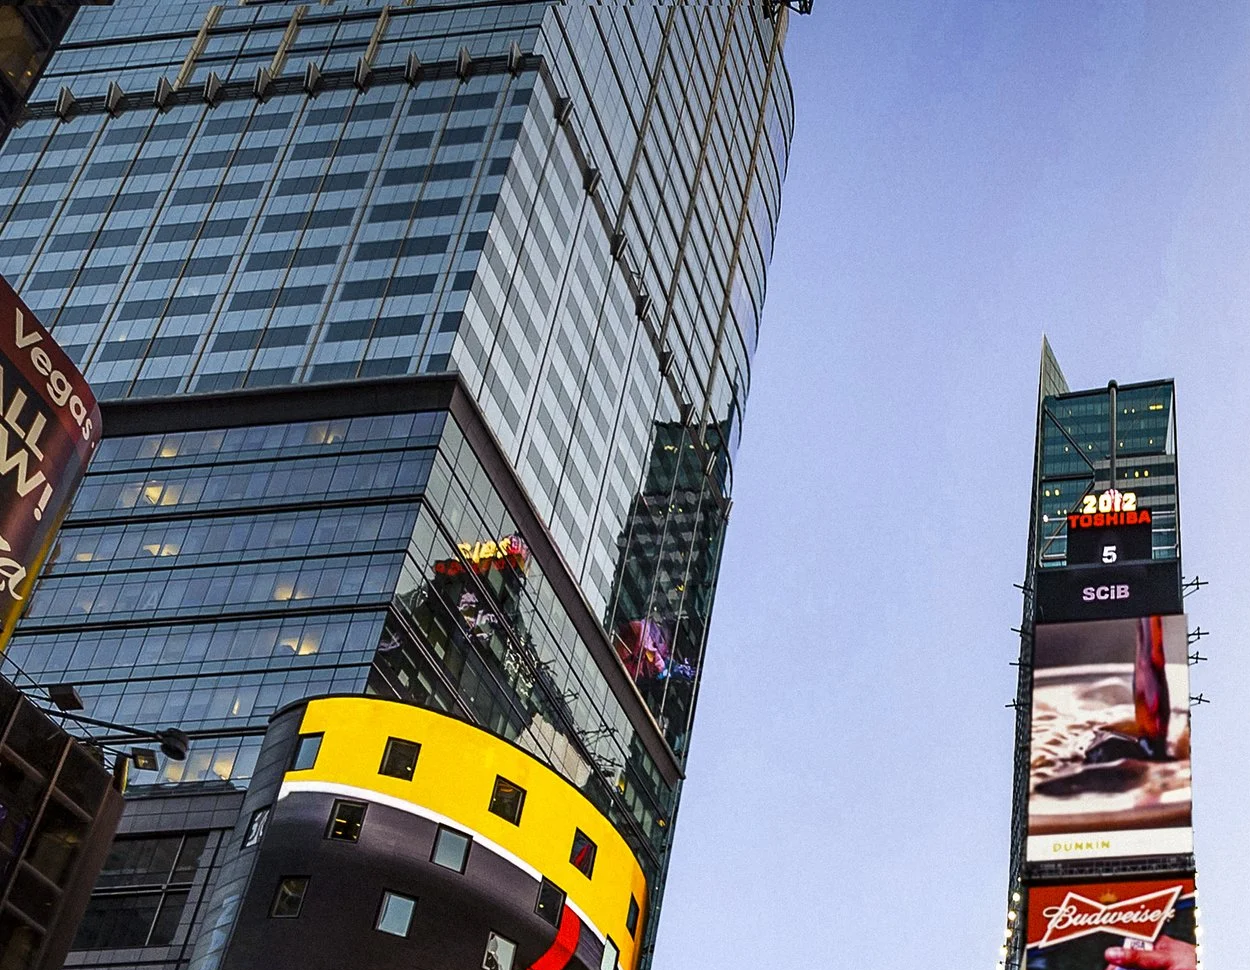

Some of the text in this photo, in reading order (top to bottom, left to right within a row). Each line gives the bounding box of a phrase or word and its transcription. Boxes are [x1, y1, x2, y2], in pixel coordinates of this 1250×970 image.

[0, 362, 44, 462] LL
[1083, 492, 1137, 514] 2012
[1067, 510, 1152, 528] TOSHIBA
[1102, 545, 1118, 563] 5
[1082, 584, 1130, 601] SCiB
[1052, 839, 1111, 853] DUNKIN
[1042, 903, 1176, 931] Budweiser
